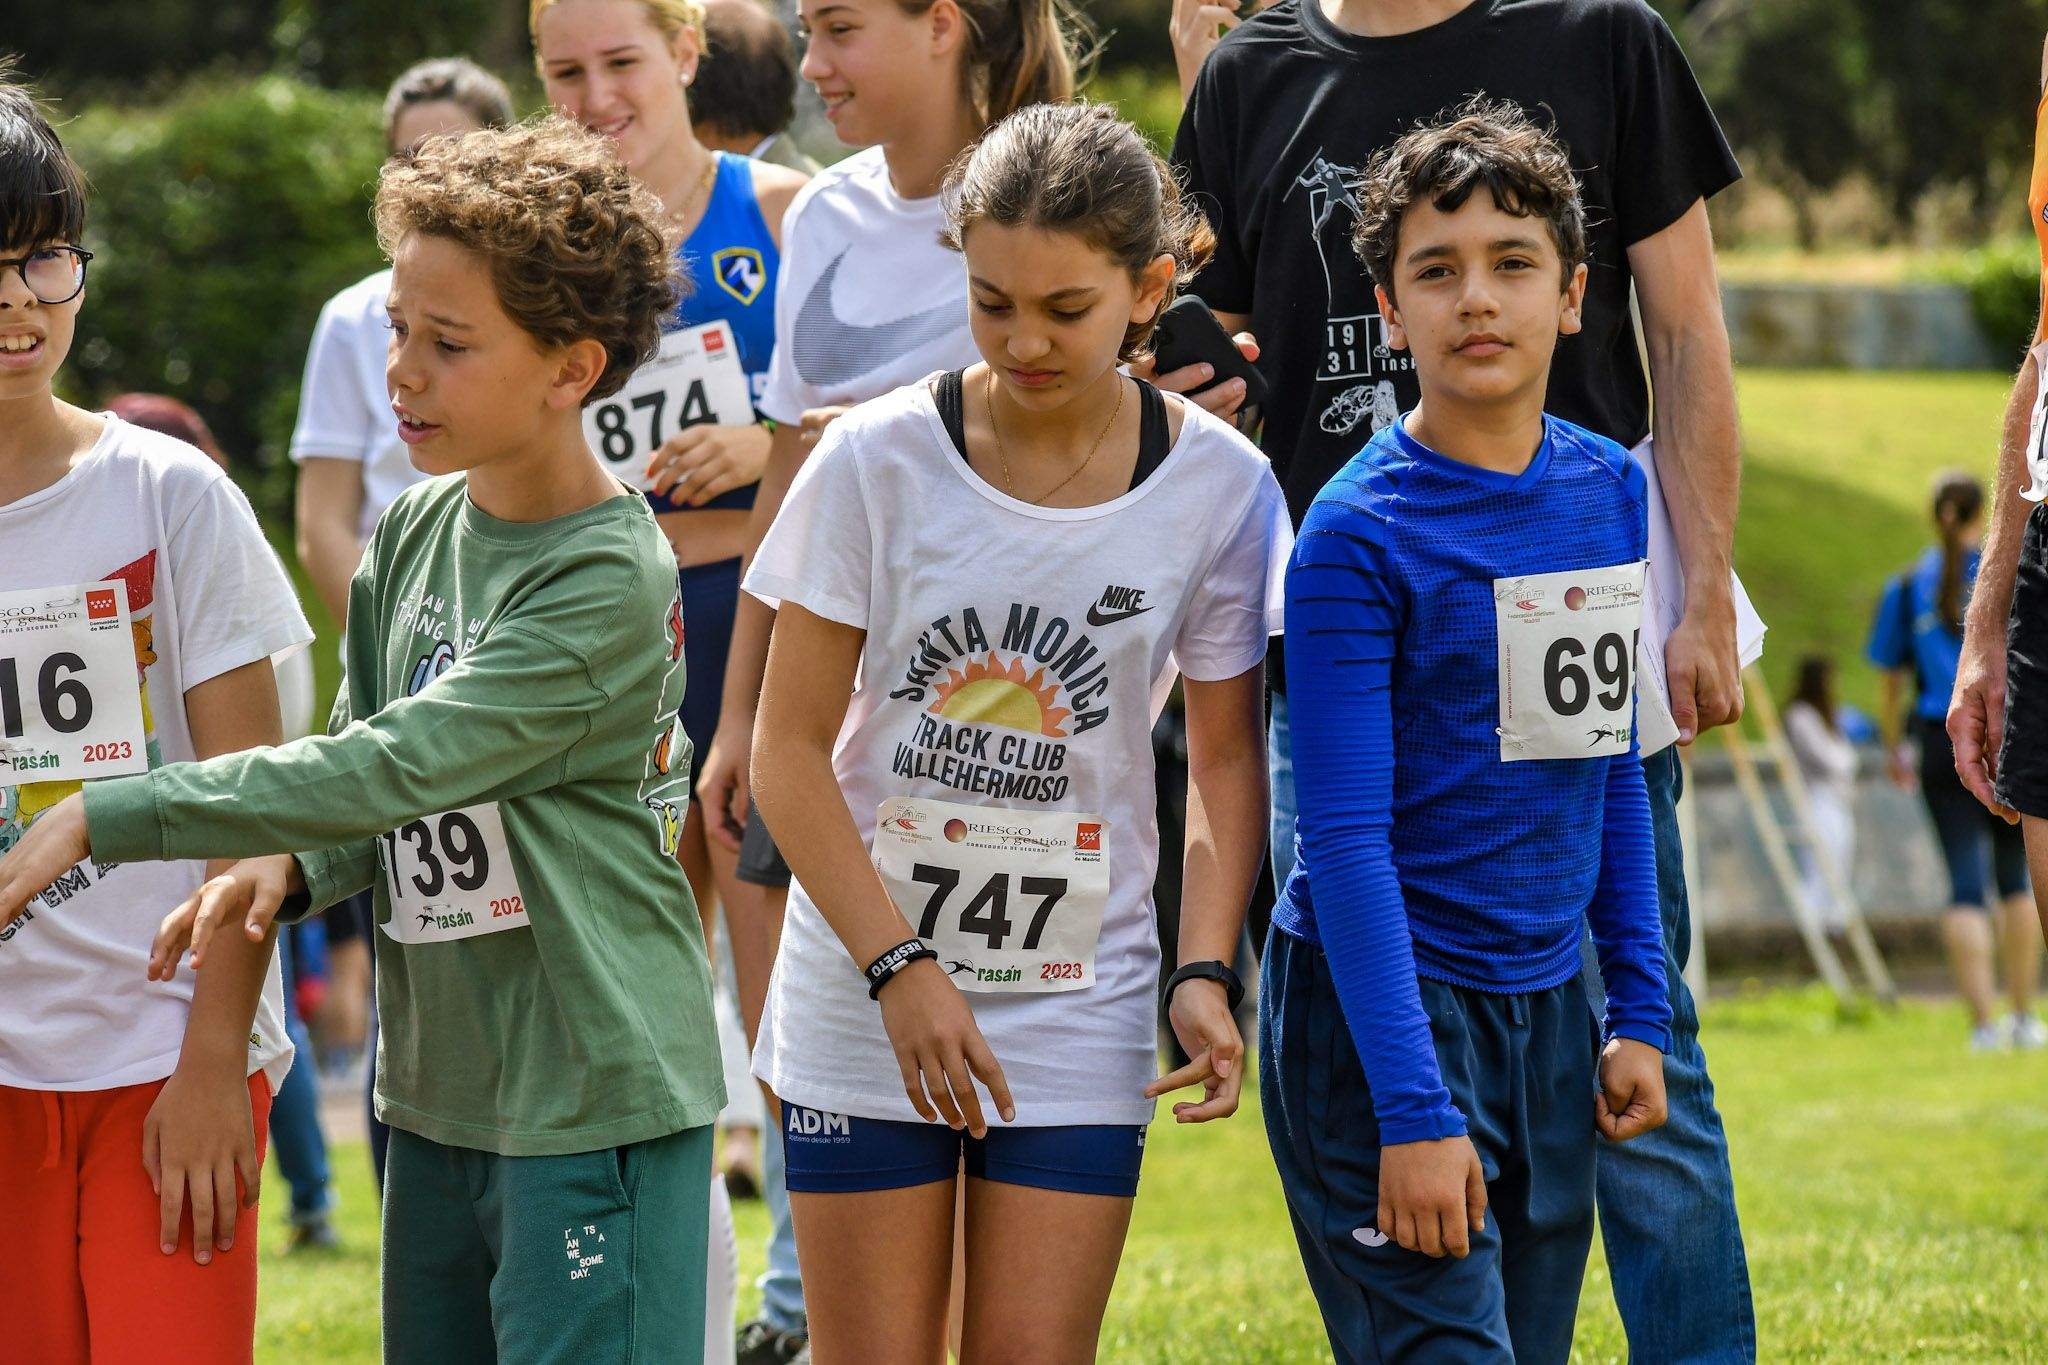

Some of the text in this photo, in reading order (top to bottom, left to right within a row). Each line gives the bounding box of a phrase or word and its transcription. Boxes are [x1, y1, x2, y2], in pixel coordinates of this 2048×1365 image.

[596, 379, 718, 462] 874
[1099, 584, 1146, 611] NIKE
[1587, 582, 1632, 596] RIESGO
[18, 611, 78, 627] gestión
[889, 603, 1109, 735] SANTA MONICA
[0, 651, 93, 738] 16
[912, 712, 1067, 771] TRACK CLUB
[12, 741, 133, 771] rasán 2023
[892, 742, 1069, 802] VALLEHERMOSO
[968, 823, 1031, 836] RIESGO
[1014, 836, 1067, 846] gestión
[490, 896, 523, 918] 202
[912, 862, 1068, 950] 747
[871, 941, 923, 977] RESPETO
[977, 963, 1083, 982] rasán 2023
[789, 1107, 850, 1135] ADM
[833, 1136, 850, 1144] 1959
[566, 1238, 579, 1249] AN
[598, 1233, 605, 1243] A
[566, 1249, 580, 1260] WE
[579, 1254, 604, 1267] SOME
[570, 1268, 591, 1280] DAY.
